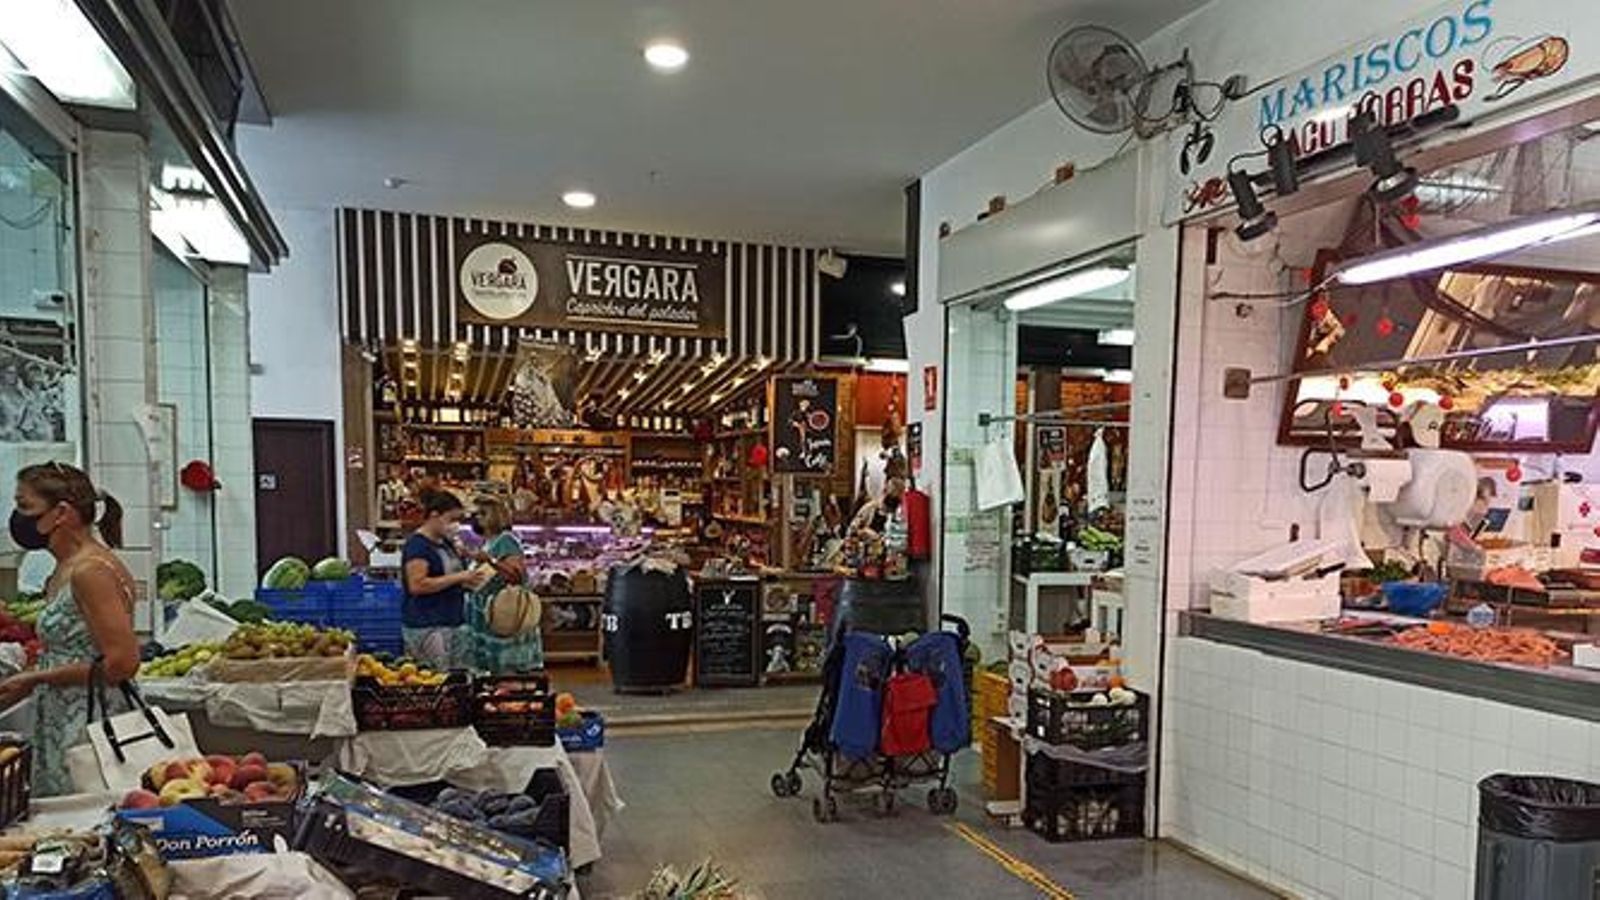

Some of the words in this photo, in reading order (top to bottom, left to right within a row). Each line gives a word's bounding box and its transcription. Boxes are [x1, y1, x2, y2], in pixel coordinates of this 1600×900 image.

[1258, 0, 1494, 126] MARISCOS
[471, 272, 527, 291] VERGARA
[566, 259, 698, 303] VERGARA
[156, 838, 191, 851] Don
[195, 829, 259, 849] Porrón
